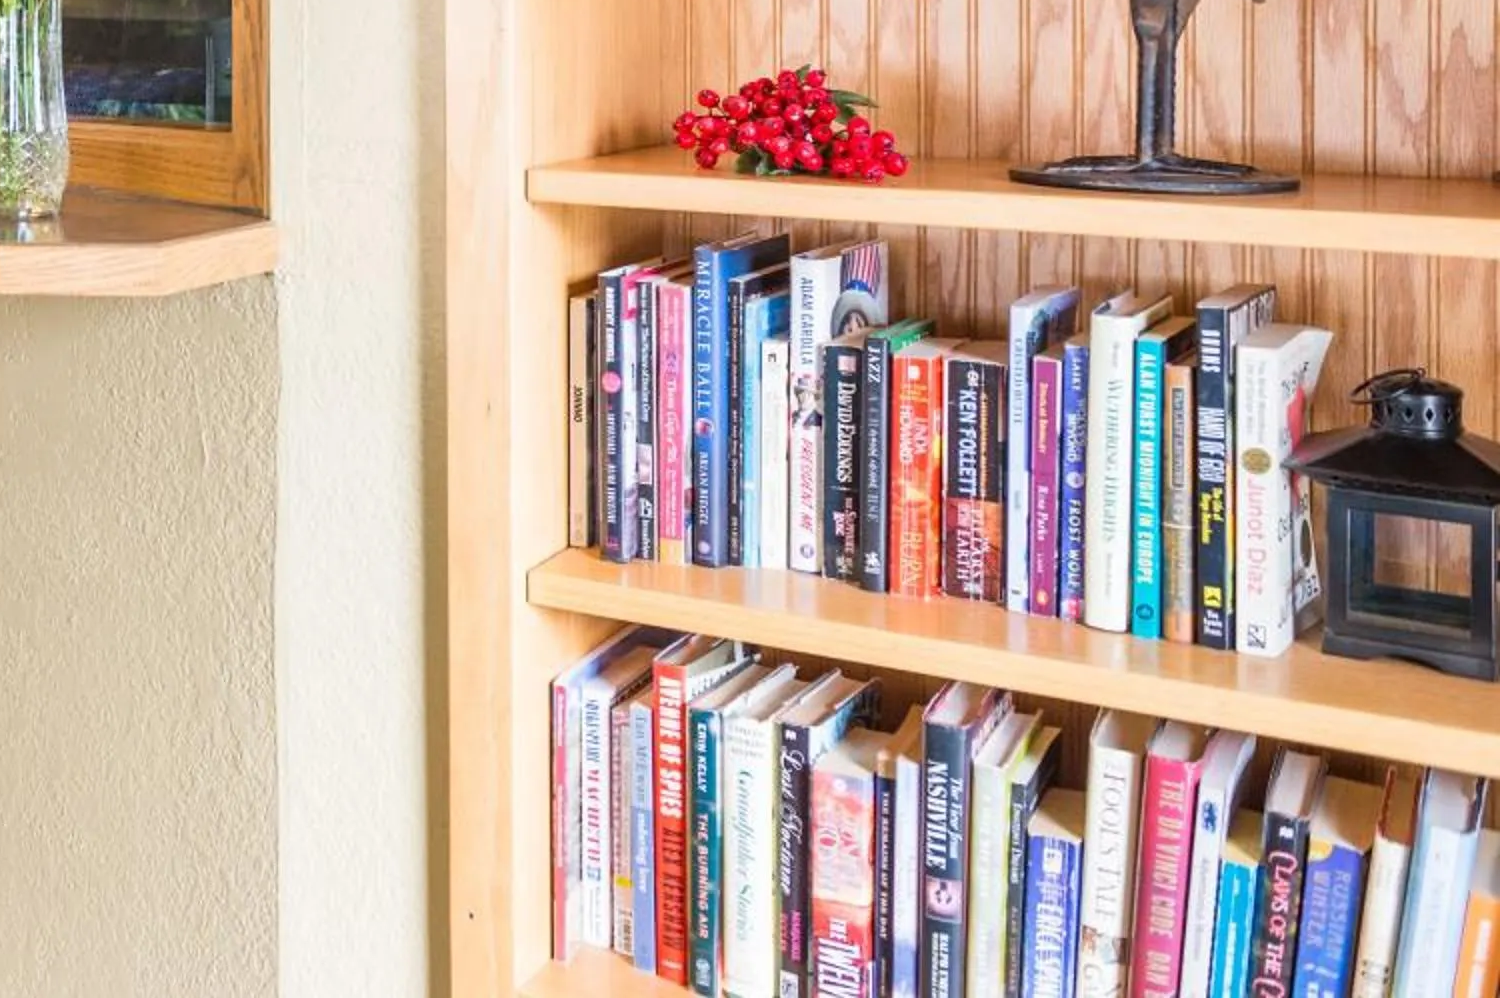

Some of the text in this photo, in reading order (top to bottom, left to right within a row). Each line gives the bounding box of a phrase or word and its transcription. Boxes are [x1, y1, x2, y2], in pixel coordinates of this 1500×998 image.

[696, 260, 712, 411] MIRACLE BALL
[800, 277, 815, 366] ADAM CAROLLA
[1201, 329, 1221, 373] BURNS
[867, 345, 882, 384] JAZZ
[836, 381, 857, 484] DAVID EDDINGS
[899, 405, 914, 464] HOWARD
[912, 418, 931, 455] LINDA
[958, 389, 978, 497] KEN FOLLETT
[1104, 378, 1124, 471] WUTHERING
[1197, 406, 1225, 483] HAND OF GOD
[698, 451, 709, 487] BRIAN
[1136, 352, 1157, 585] ALAN FURST MIDNIGHT IN EUROPE
[970, 508, 985, 580] PILLARS
[1036, 511, 1050, 542] Parks
[1067, 499, 1082, 591] FROST WOLF
[1101, 475, 1120, 543] HEIGHTS
[1245, 477, 1268, 596] Junot Díaz
[956, 529, 972, 580] EARTH
[658, 676, 682, 820] AVENUE OF SPIES
[697, 721, 708, 794] ERIN KELLY
[780, 746, 806, 800] Last
[730, 769, 756, 877] Grandfather
[924, 758, 950, 871] NASHVILLE
[949, 777, 964, 801] The
[661, 827, 684, 951] ALEX KERSHAW
[697, 812, 709, 940] THE BURNING AIR
[1094, 864, 1123, 922] TALE
[1149, 779, 1186, 938] THE DA VINCI CODE
[1267, 850, 1299, 914] CLAWS
[828, 918, 848, 942] THE
[1035, 901, 1067, 952] ERICA
[1268, 914, 1288, 940] OF
[1306, 868, 1331, 948] WINTER
[1326, 869, 1352, 960] RUSSIAN
[817, 937, 862, 998] TWELV
[1265, 941, 1286, 977] THE
